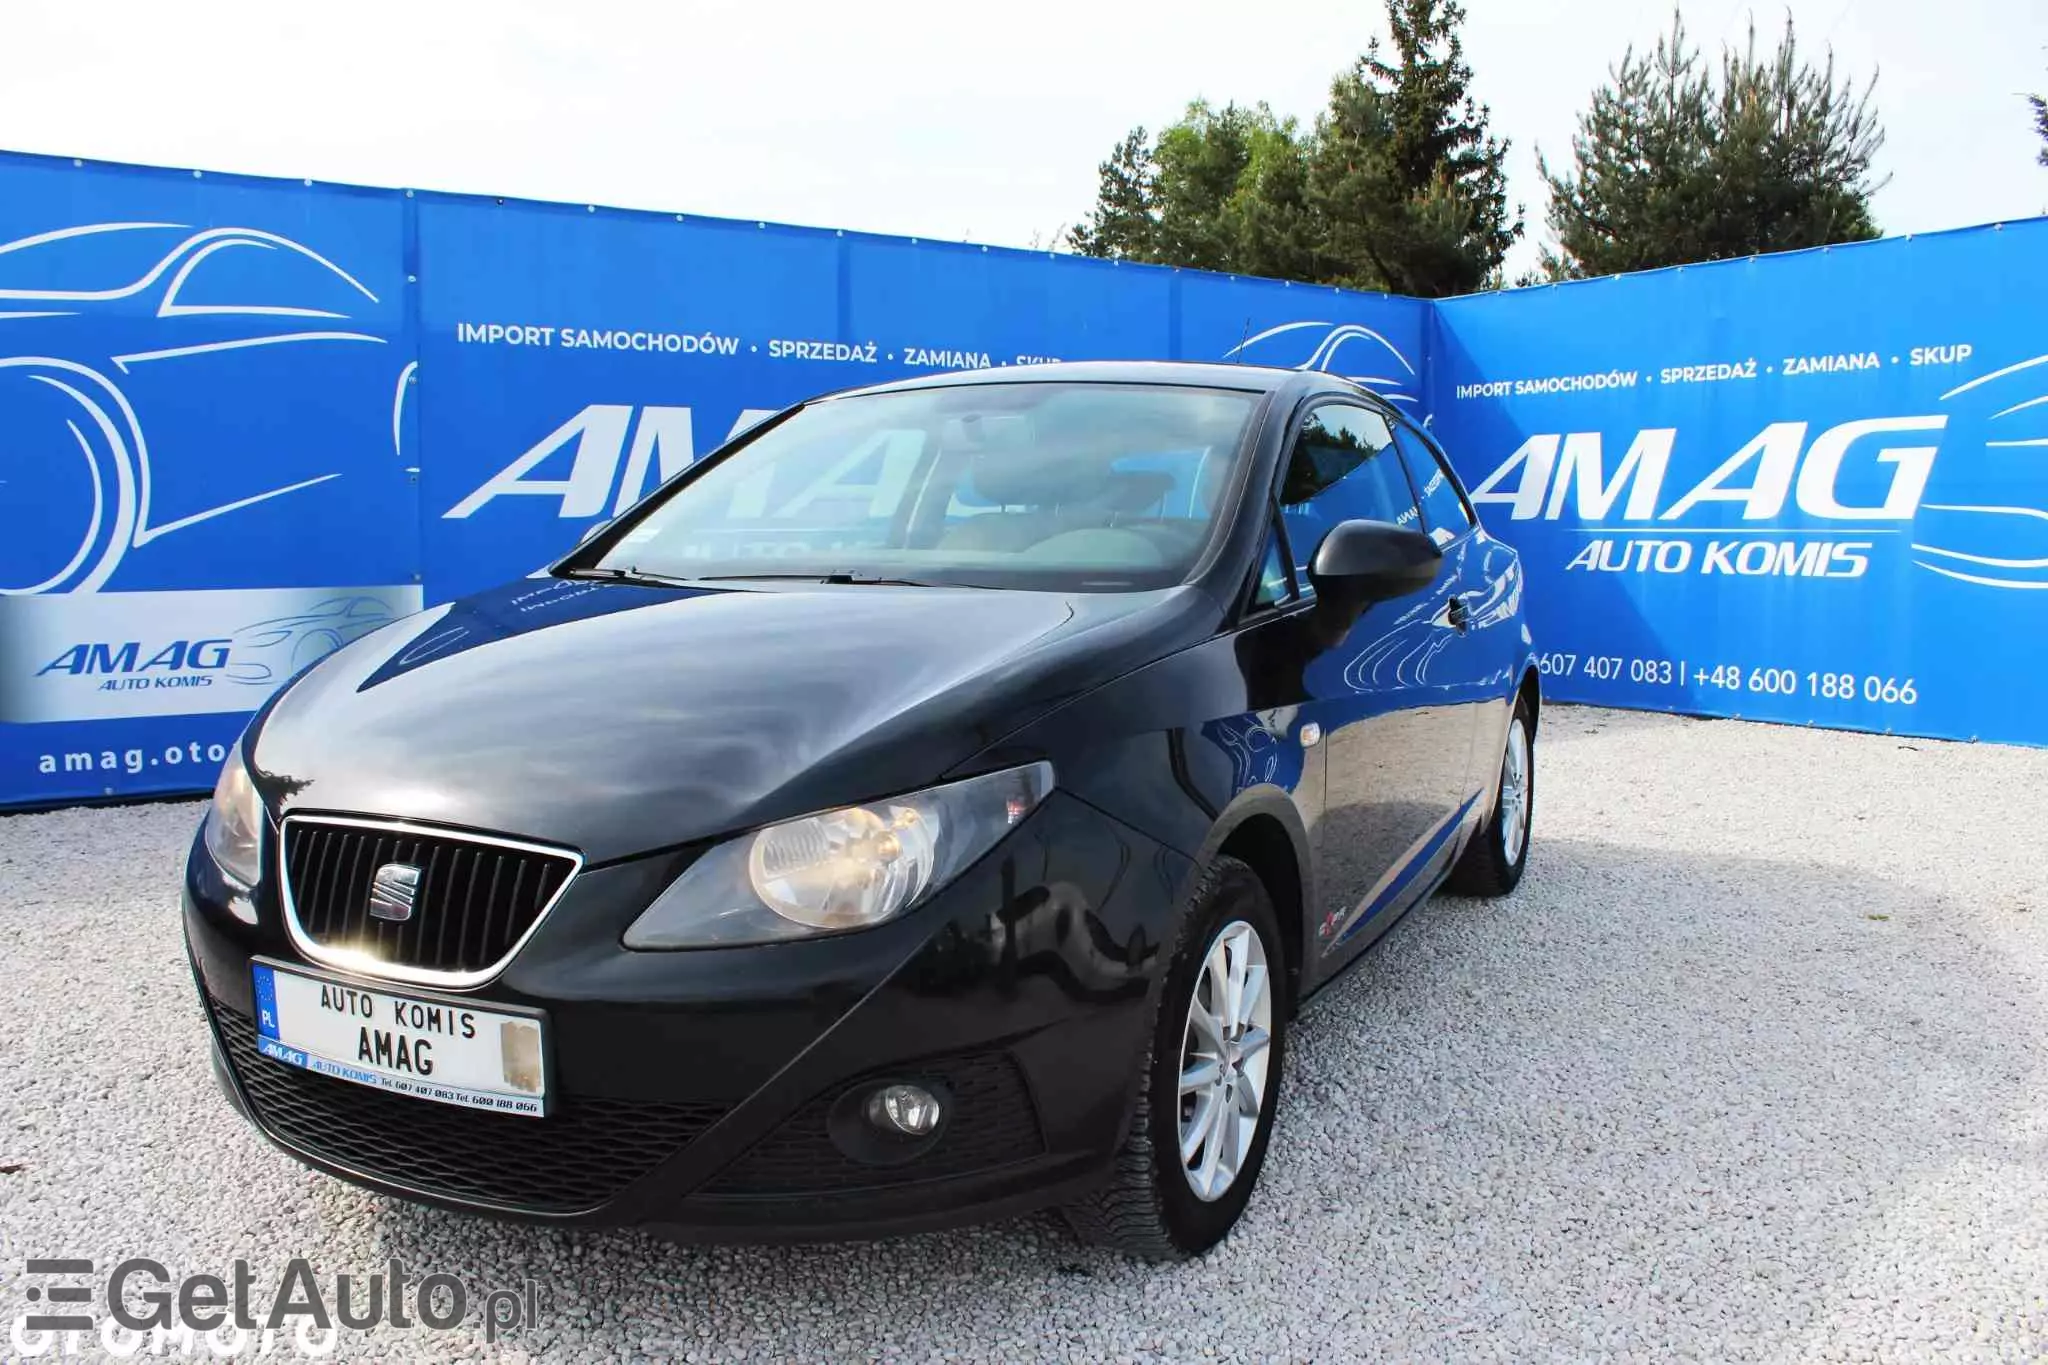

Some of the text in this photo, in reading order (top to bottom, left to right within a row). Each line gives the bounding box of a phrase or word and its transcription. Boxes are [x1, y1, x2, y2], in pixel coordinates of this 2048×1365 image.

[457, 323, 554, 345] IMPORT
[560, 329, 739, 354] SAMOCHODÓW
[768, 338, 878, 364] SPRZEDAŻ
[903, 347, 992, 369] ZAMIANA
[1456, 344, 1973, 399] IMPORT SAMOCHODÓW SPRZEDAŻ ZAMIANA SKUP
[1565, 540, 1874, 578] AUTO KOMIS
[35, 639, 233, 677] AMAG
[1540, 653, 1918, 705] 607 407 083 +48 600 188 066
[98, 675, 213, 691] AUTO KOMIS
[262, 1010, 275, 1028] PL
[321, 983, 477, 1040] AUTO KOMIS
[358, 1027, 433, 1075] AMAG
[263, 1043, 304, 1066] AMAG
[312, 1059, 340, 1076] AUTO
[342, 1067, 377, 1085] KOMIS
[395, 1080, 413, 1092] 607
[415, 1085, 433, 1098] 407
[434, 1089, 455, 1101] 083
[472, 1095, 494, 1106] 600
[496, 1099, 514, 1110] 188
[515, 1102, 538, 1113] 066
